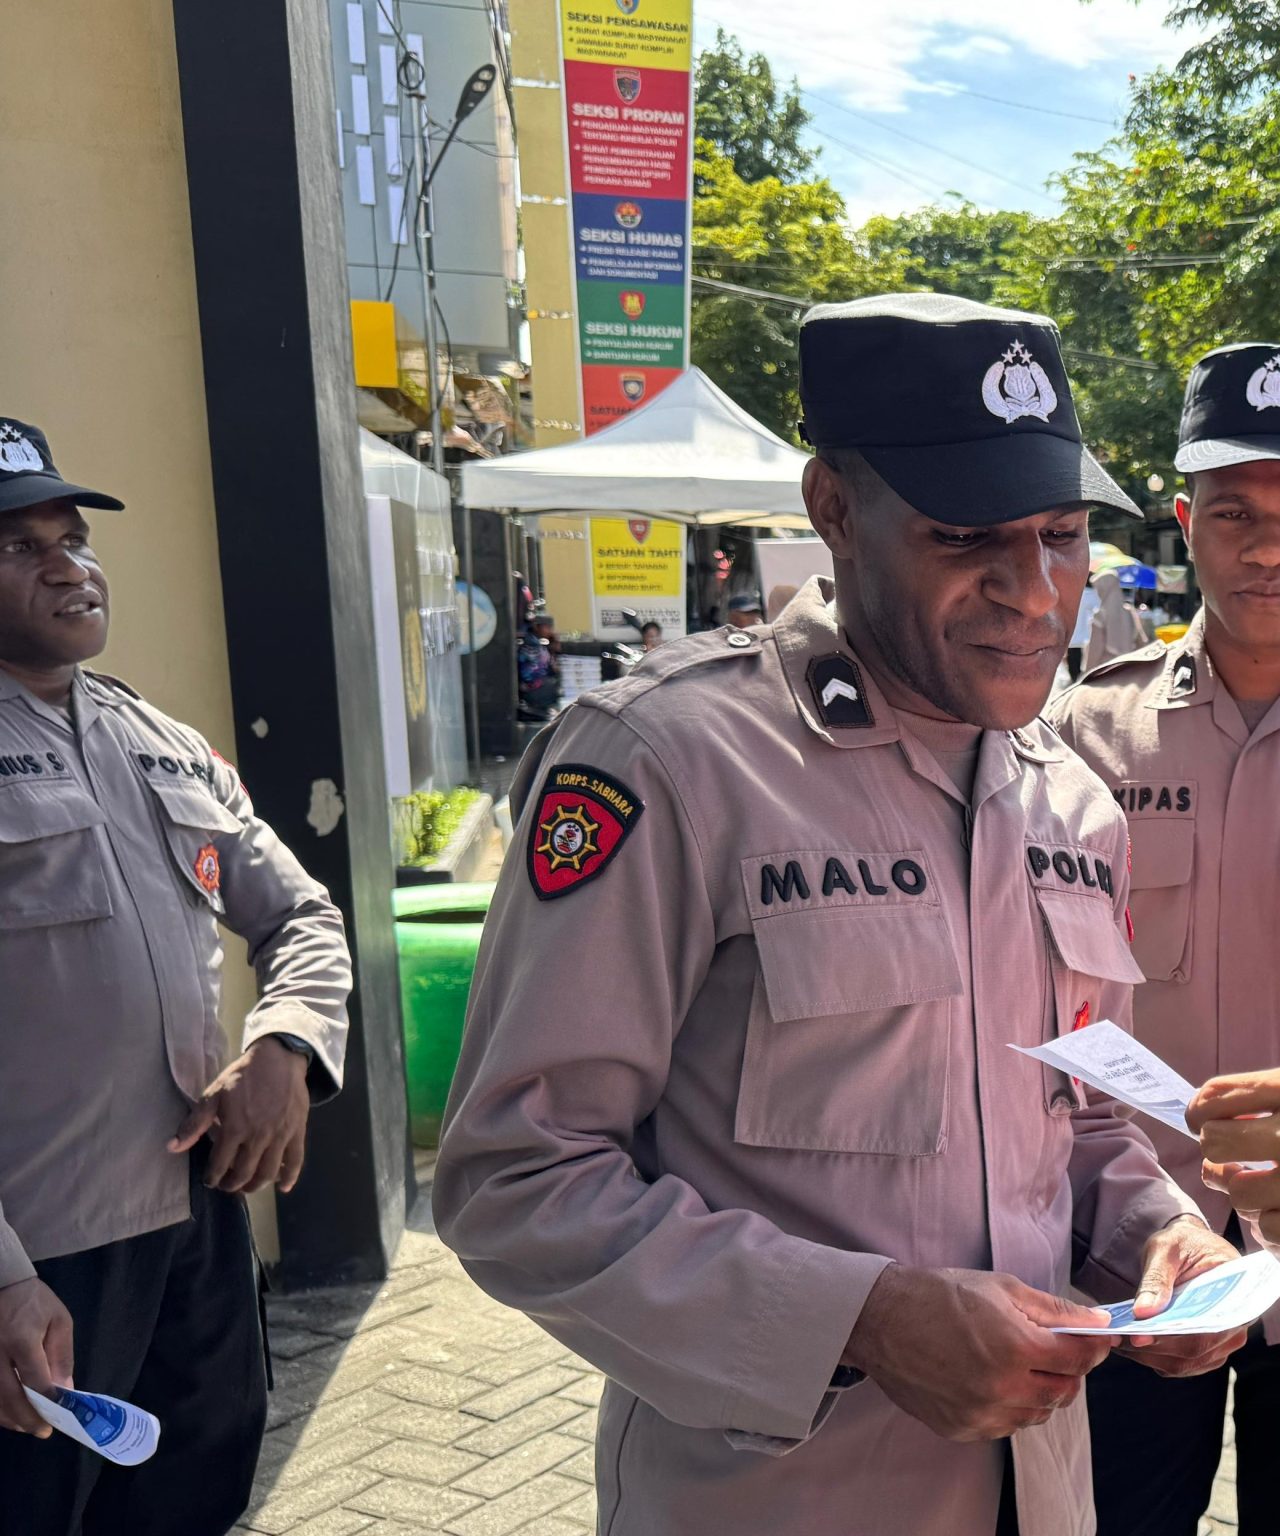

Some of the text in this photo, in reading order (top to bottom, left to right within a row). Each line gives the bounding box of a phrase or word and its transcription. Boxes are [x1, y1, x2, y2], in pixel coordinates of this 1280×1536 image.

[567, 11, 689, 33] SEKSI PENGAWASAN
[572, 102, 685, 125] SEKSI PROPAM
[580, 227, 683, 247] SEKSI HUMAS
[585, 322, 683, 338] SEKSI HUKUM
[598, 548, 645, 557] SATUAN
[760, 857, 927, 906] MALO
